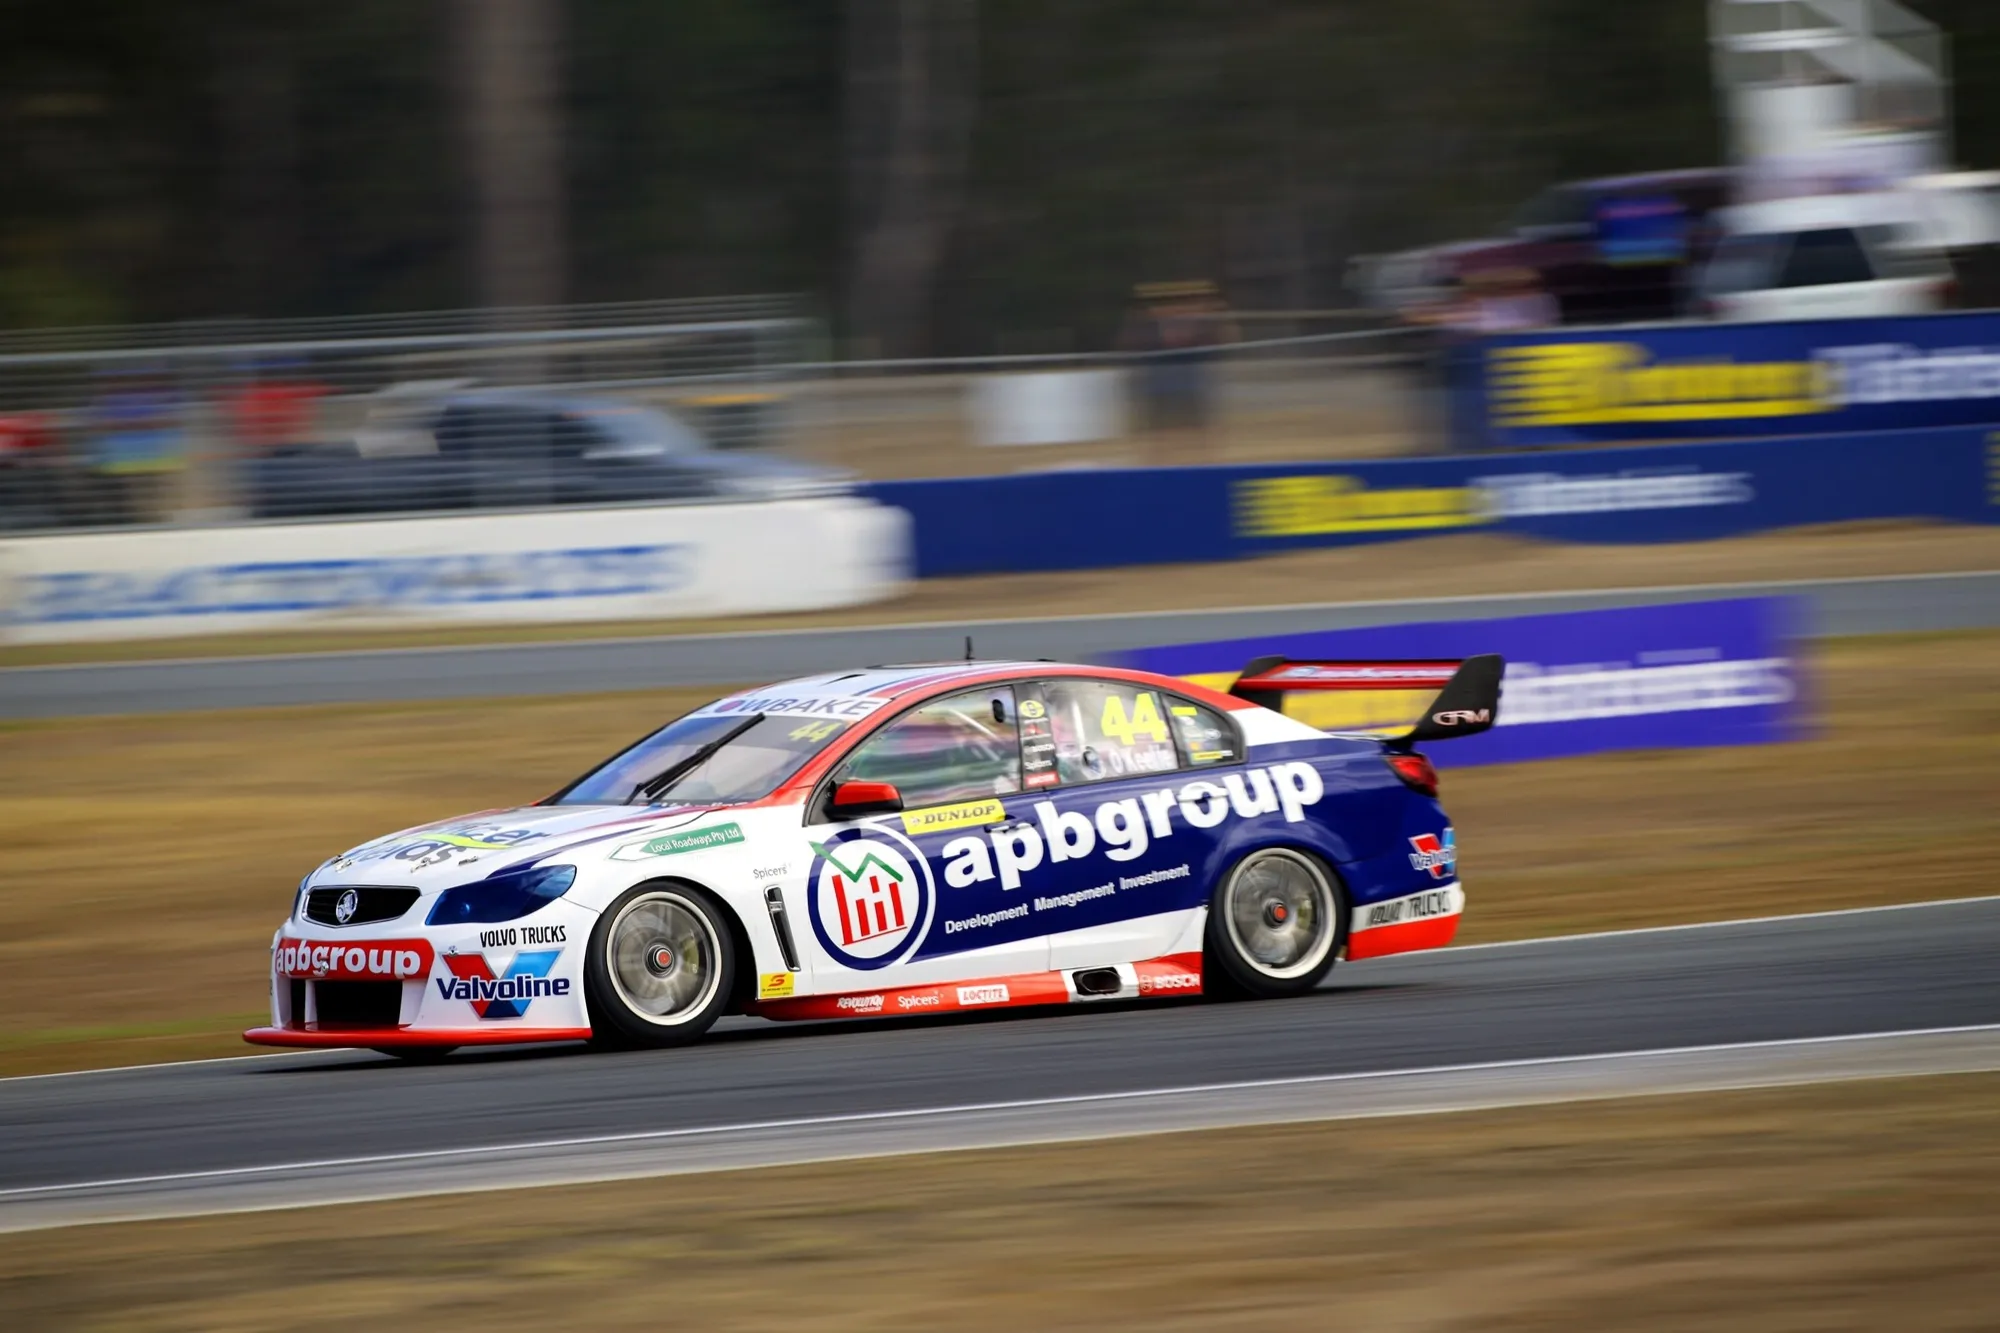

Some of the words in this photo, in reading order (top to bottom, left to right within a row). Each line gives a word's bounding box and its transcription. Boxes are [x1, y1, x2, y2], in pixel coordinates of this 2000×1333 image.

[1101, 693, 1167, 745] 44
[788, 720, 842, 743] 44
[923, 805, 997, 825] DUNLOP
[942, 761, 1324, 891] apbgroup
[651, 840, 672, 854] Local
[673, 834, 712, 850] Roadways
[711, 831, 725, 843] Pty
[726, 828, 740, 839] Ltd
[752, 866, 788, 880] Spicers
[945, 903, 1029, 934] Development
[1034, 882, 1116, 911] Management
[1119, 864, 1190, 890] Investment
[480, 927, 517, 948] VOLVO
[521, 925, 567, 944] TRUCKS
[275, 940, 421, 979] apbgroup
[436, 974, 570, 1001] Valvoline
[1155, 973, 1200, 989] BOSCH
[837, 995, 885, 1008] REVOLUTION
[897, 994, 940, 1009] Spicers
[962, 987, 1005, 1001] LOCTITE
